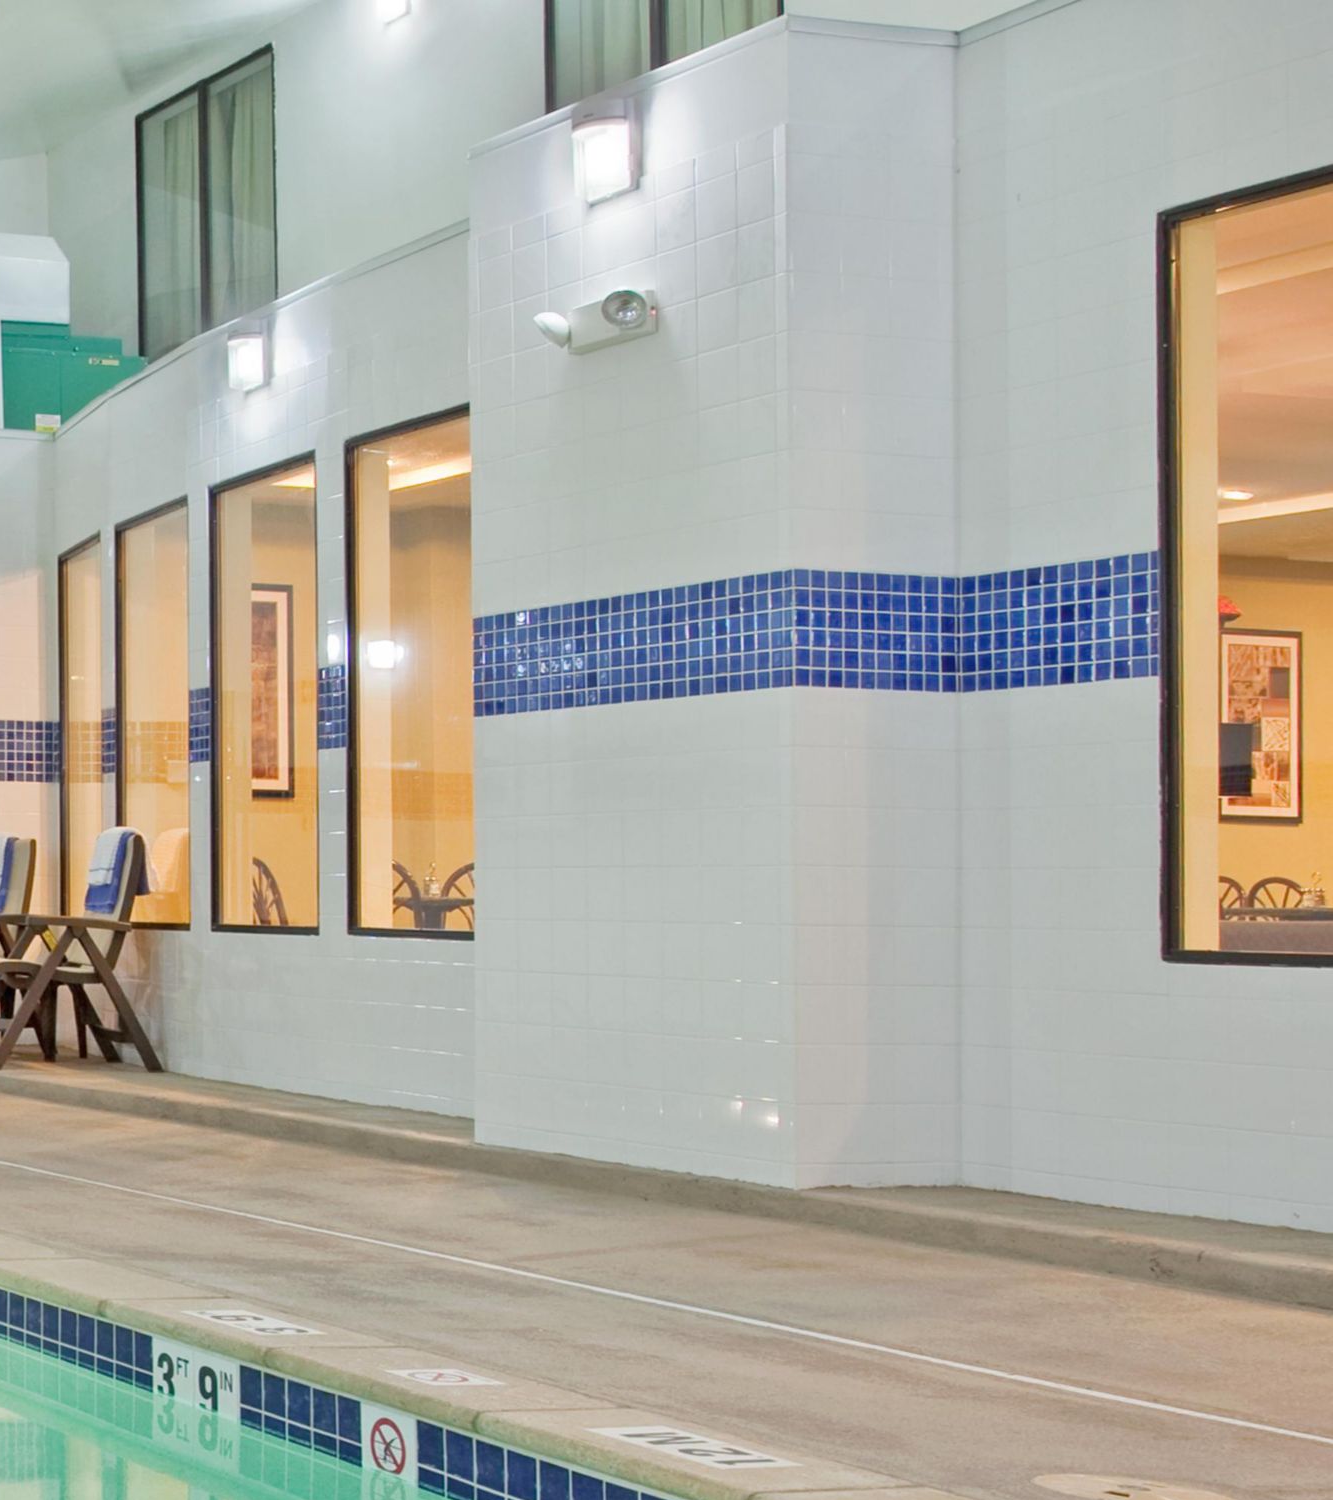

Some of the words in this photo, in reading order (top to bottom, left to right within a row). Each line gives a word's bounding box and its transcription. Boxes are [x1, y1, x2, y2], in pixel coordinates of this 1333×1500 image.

[157, 1353, 175, 1396] 3
[176, 1357, 189, 1378] FT
[198, 1366, 218, 1411] 9
[220, 1371, 233, 1393] IN
